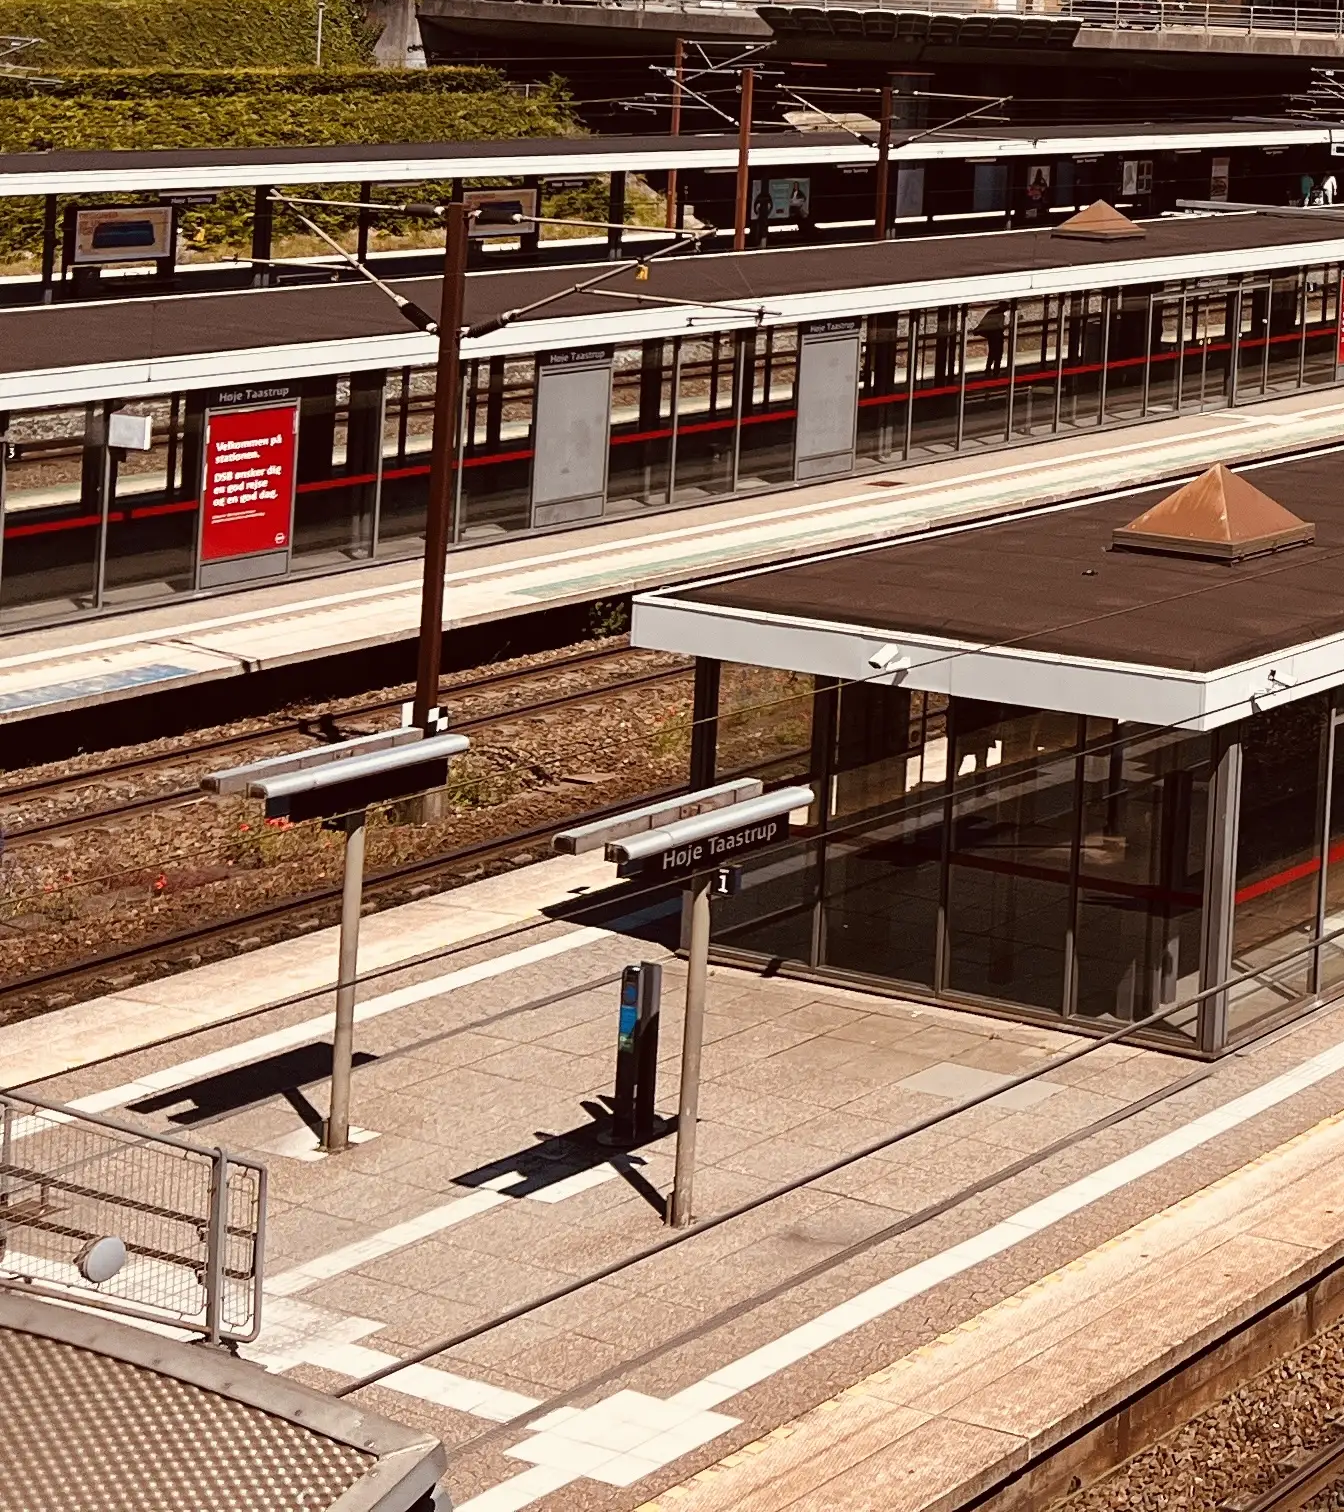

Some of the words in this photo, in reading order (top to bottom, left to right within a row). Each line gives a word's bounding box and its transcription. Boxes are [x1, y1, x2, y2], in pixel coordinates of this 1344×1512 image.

[245, 387, 290, 400] Taastrup
[707, 822, 777, 855] Taastrup
[717, 874, 728, 894] 1
